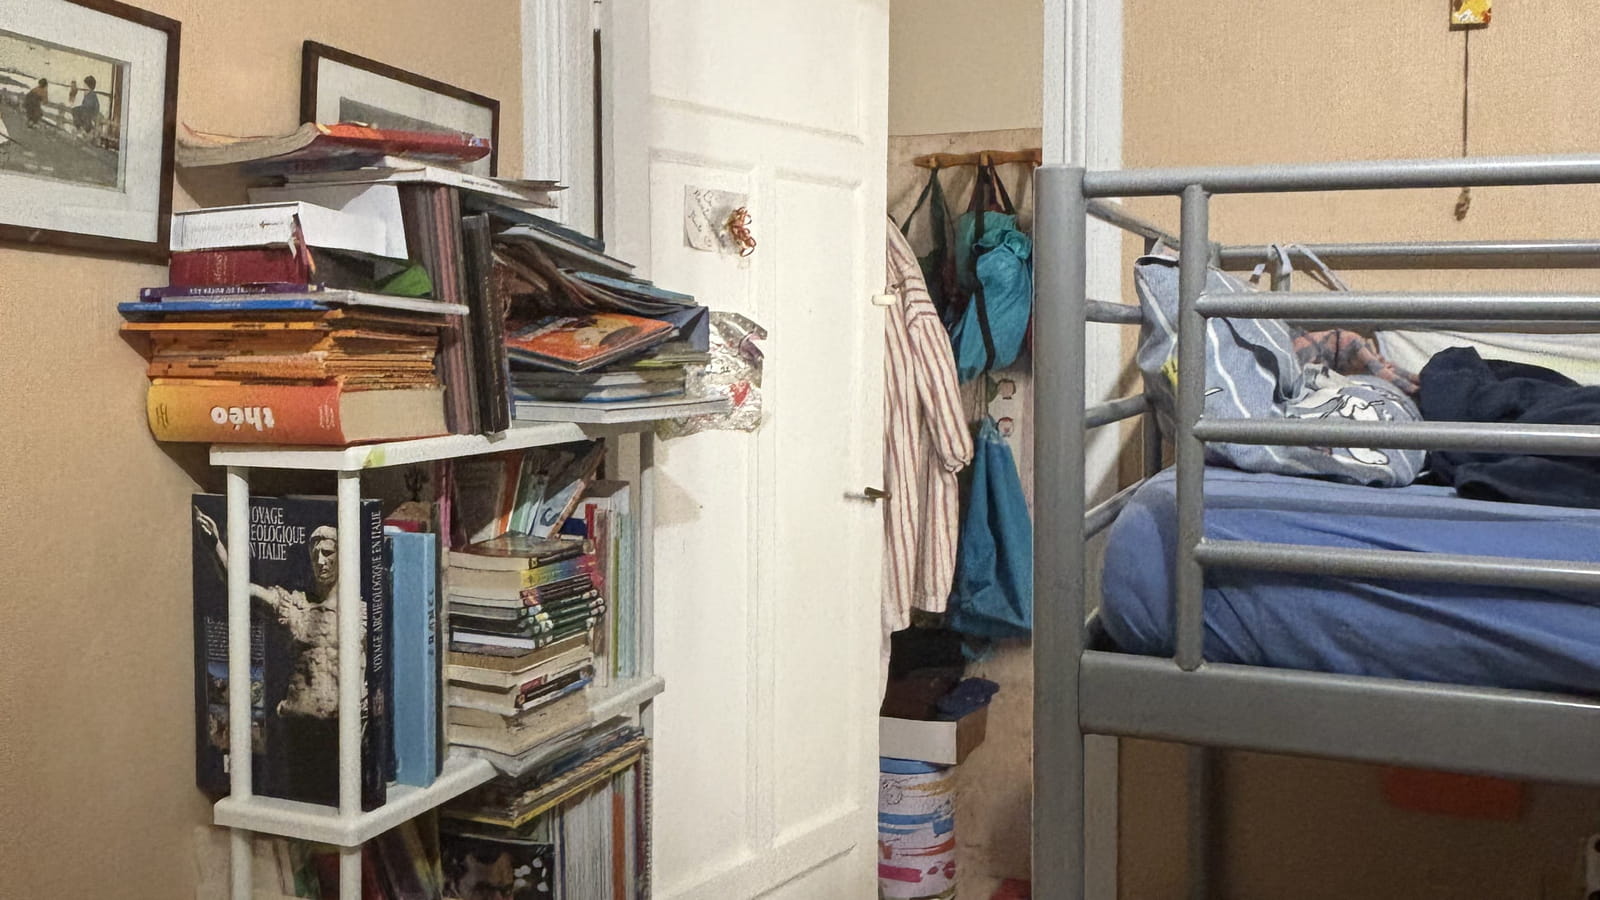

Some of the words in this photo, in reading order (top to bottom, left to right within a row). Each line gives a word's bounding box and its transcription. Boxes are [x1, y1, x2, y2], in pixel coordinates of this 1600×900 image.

[210, 406, 275, 431] théo
[251, 506, 284, 525] OYAGE
[250, 524, 306, 546] EOLOGIQUE
[258, 542, 287, 561] ITALIE
[371, 541, 381, 554] EN
[372, 633, 383, 672] VOYAGE
